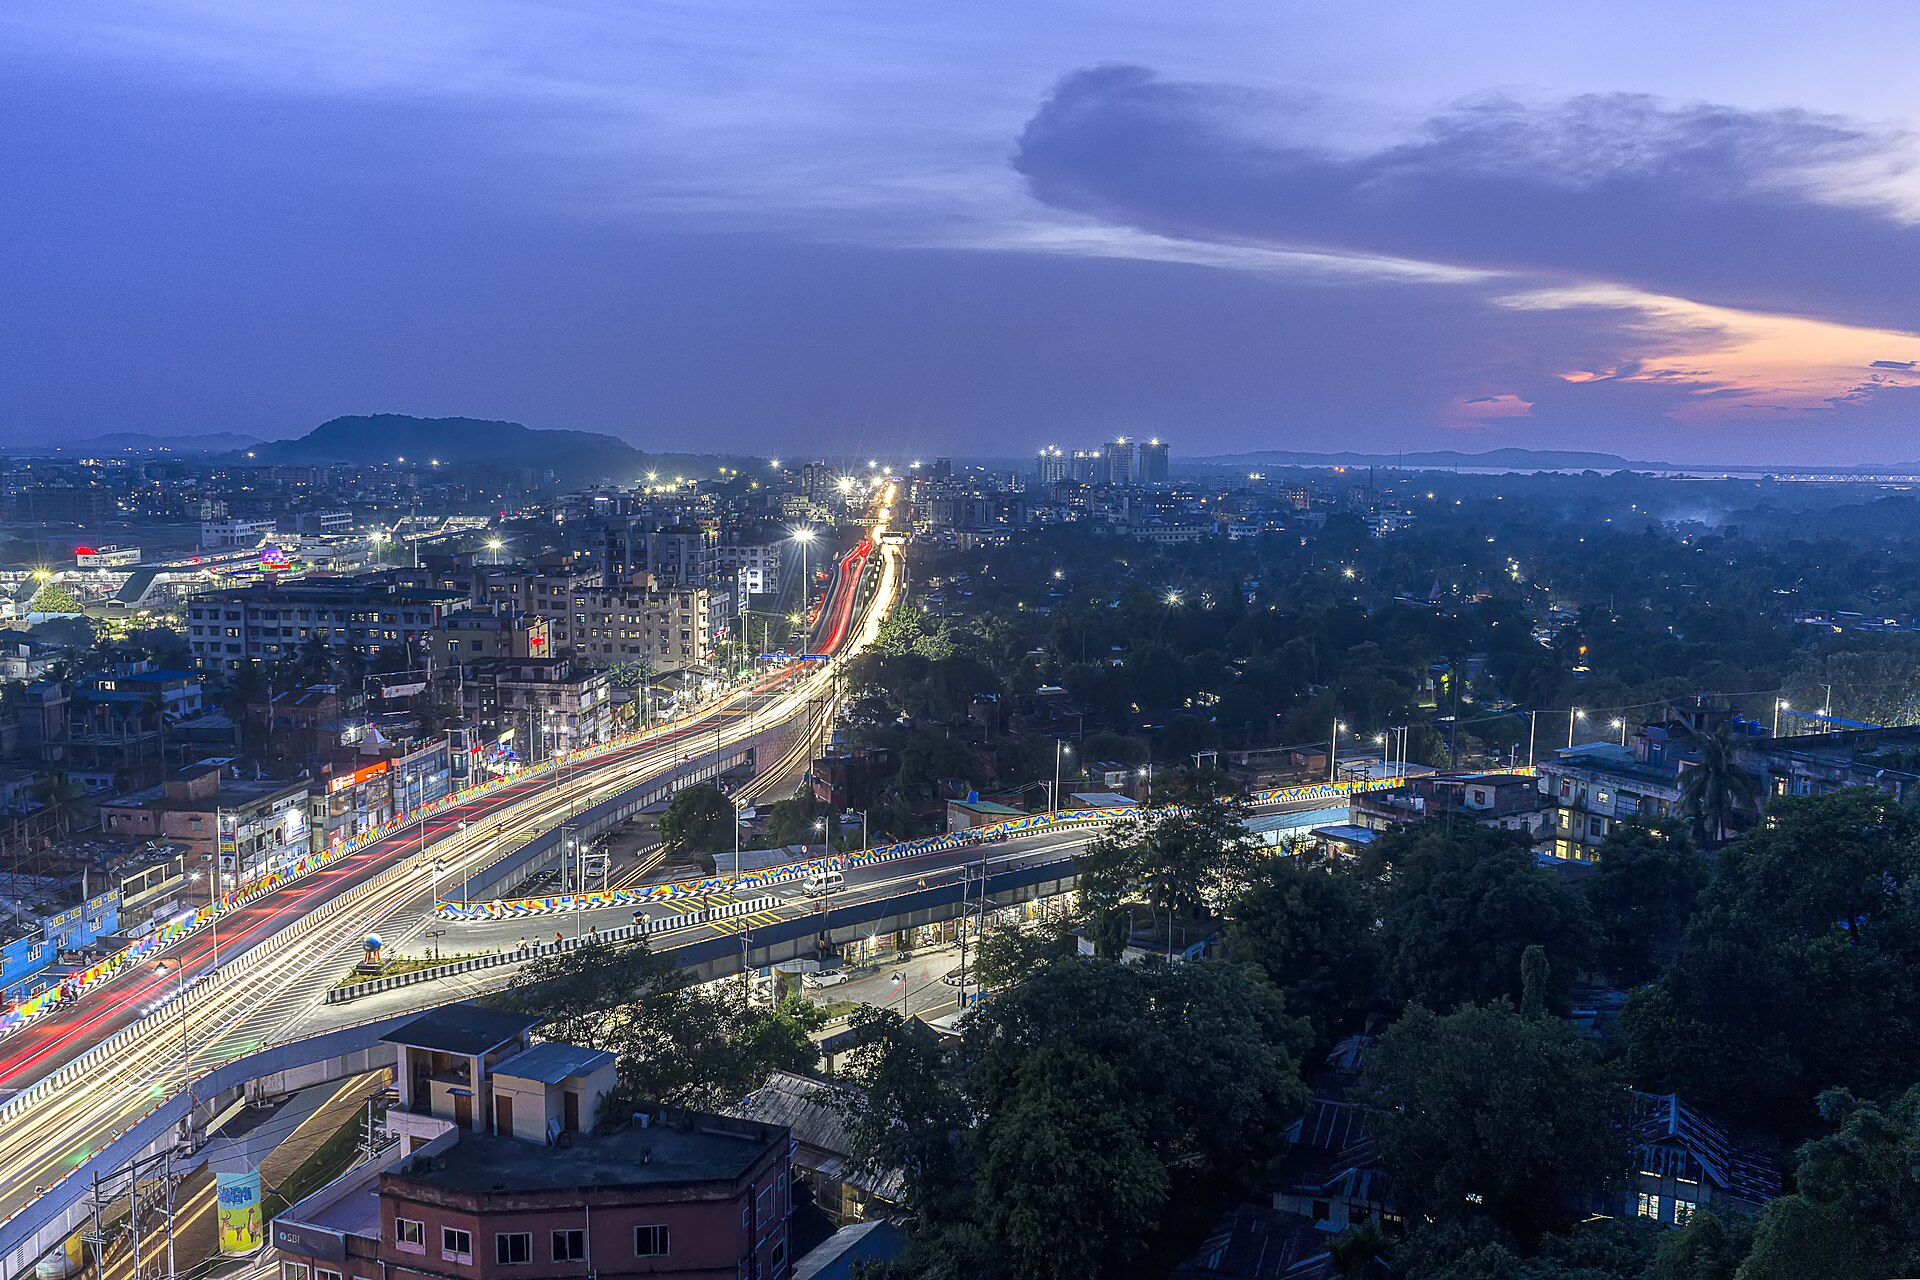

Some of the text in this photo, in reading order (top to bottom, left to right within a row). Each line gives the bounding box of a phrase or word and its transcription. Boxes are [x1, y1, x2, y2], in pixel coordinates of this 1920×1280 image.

[108, 891, 117, 901] LIC
[92, 899, 102, 909] LIC
[71, 907, 81, 918] LIC
[54, 915, 64, 926] LIC
[287, 1233, 300, 1244] SBI
